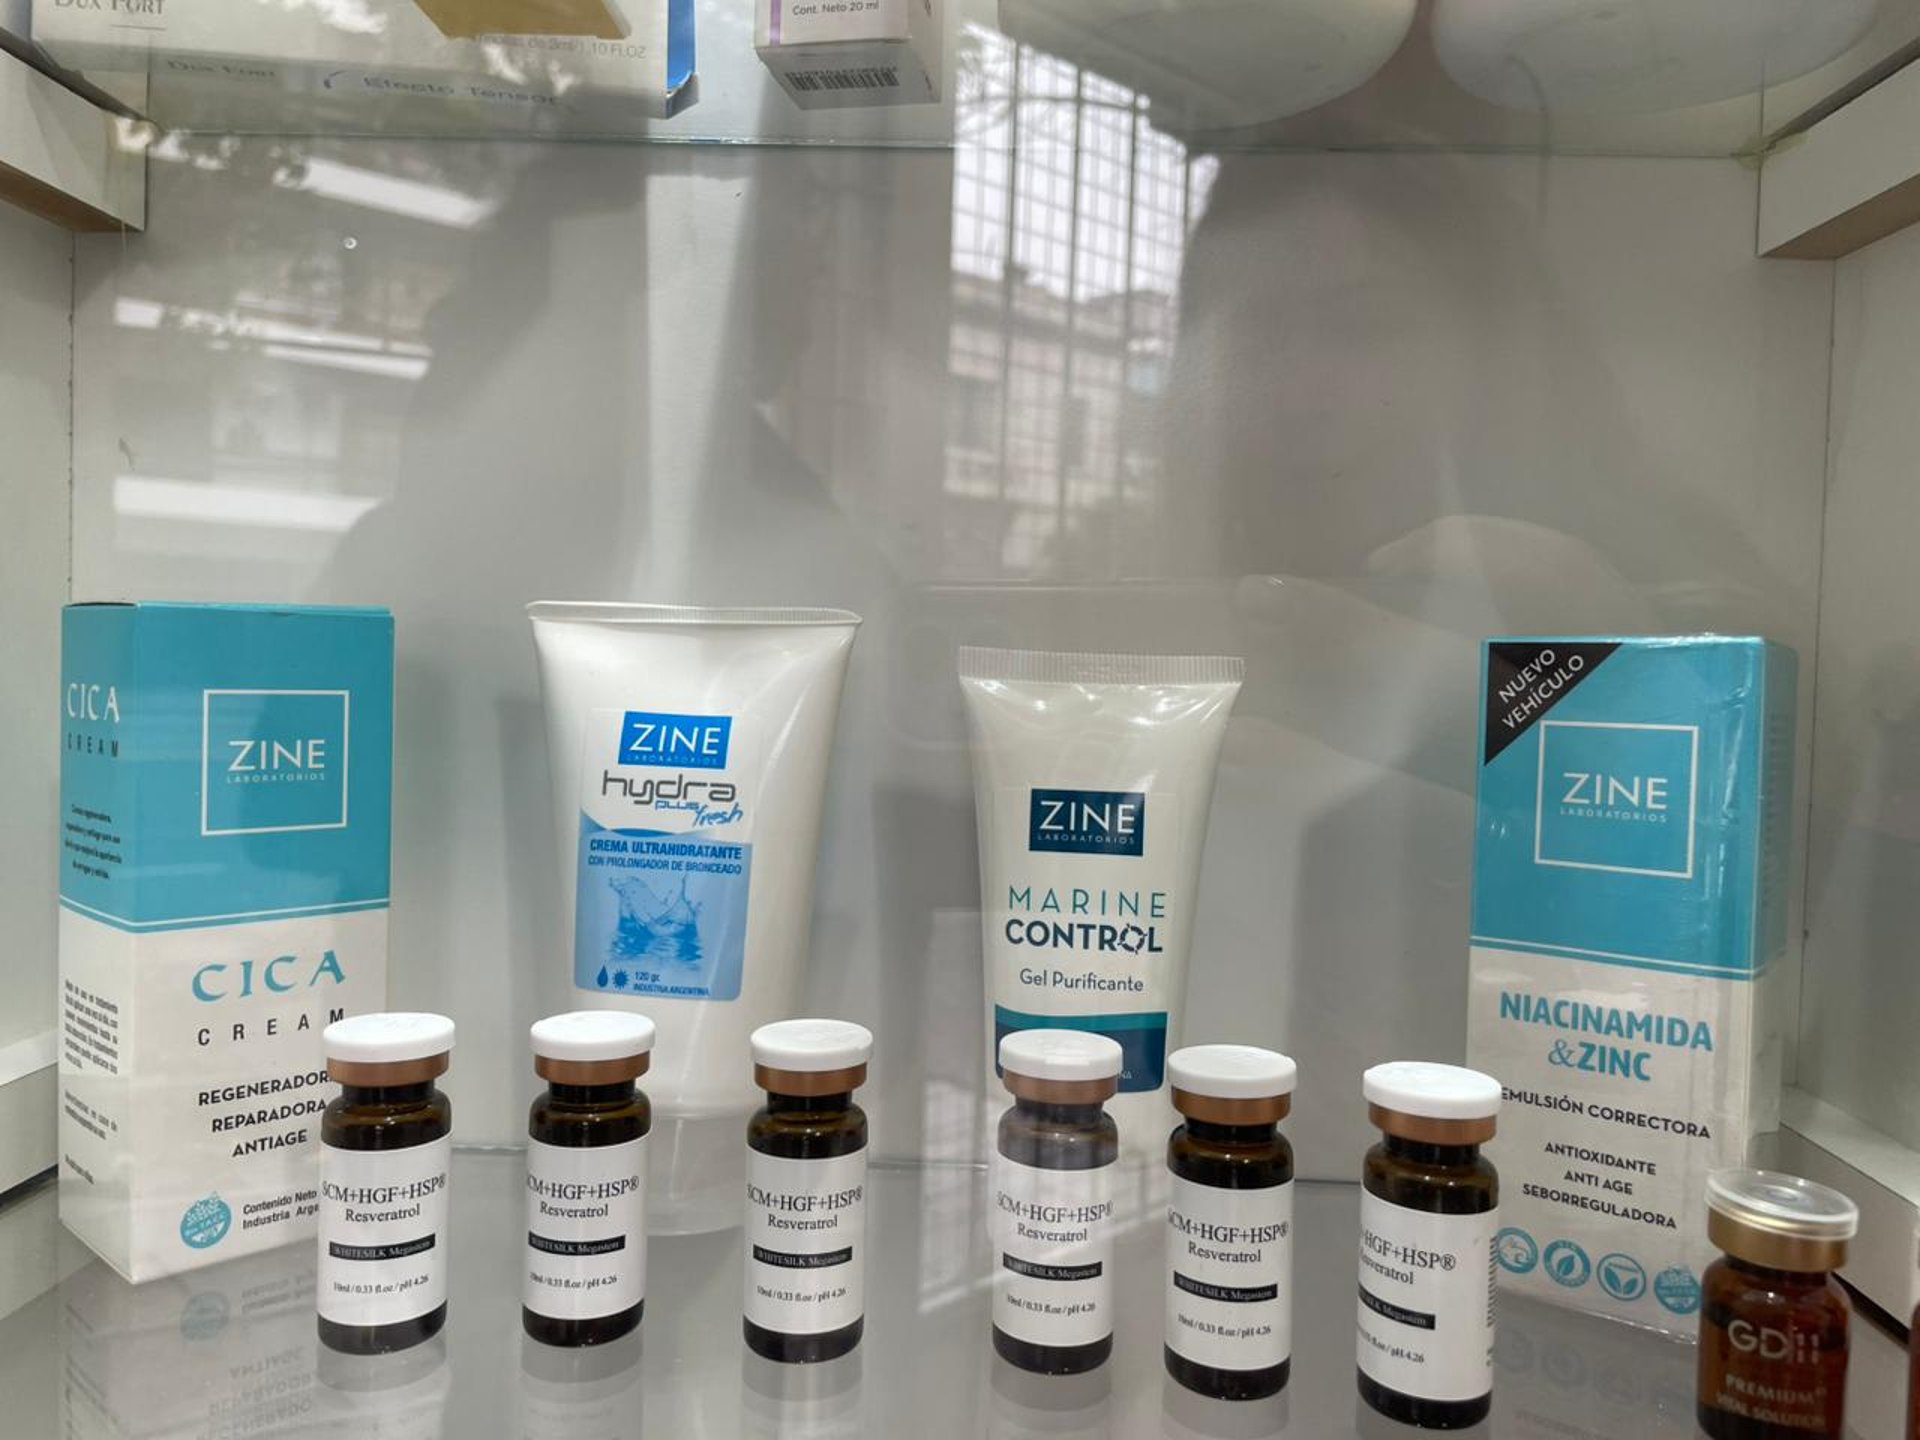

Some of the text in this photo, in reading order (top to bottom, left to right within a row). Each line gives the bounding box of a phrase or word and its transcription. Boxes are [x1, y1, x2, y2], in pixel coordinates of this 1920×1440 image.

[793, 0, 879, 16] Cont. Neto 20 ml
[1498, 649, 1556, 705] NUEVO
[1501, 653, 1585, 730] VEHÍCULO
[67, 682, 120, 724] CICA
[227, 739, 325, 771] ZINE
[629, 723, 722, 755] ZINE
[226, 772, 325, 784] LABORATORIOS
[602, 769, 737, 805] hydra
[1561, 772, 1669, 810] ZINE
[692, 802, 744, 828] fresh
[1039, 800, 1136, 834] ZINE
[1560, 806, 1668, 824] LABORATORIOS
[589, 839, 743, 860] CREMA ULTRAHIDRATANTE
[1037, 834, 1136, 845] LABORATORIOS
[588, 855, 742, 875] CON PROLONGADOR DE BRONCEADO
[1008, 884, 1167, 918] MARINE
[1005, 918, 1164, 955] CONTROL
[192, 949, 346, 1002] CICA
[1019, 967, 1145, 992] Gel Purificante
[197, 1007, 345, 1046] CREAM
[1500, 990, 1713, 1052] NIACINAMIDA
[1547, 1038, 1652, 1081] &ZINC
[198, 1070, 329, 1106] REGENERADOR
[212, 1099, 327, 1133] REPARADORA
[1501, 1086, 1711, 1139] EMULSIÓN CORRECTORA
[232, 1129, 308, 1157] ANTIAGE
[1544, 1141, 1657, 1176] ANTIOXIDANTE
[1563, 1169, 1633, 1196] ANTI AGE
[242, 1211, 290, 1230] Industria
[296, 1203, 319, 1217] Arge
[243, 1190, 317, 1215] Contenido Neto
[345, 1203, 420, 1222] Resveratrol
[540, 1200, 609, 1218] Resveratrol
[1522, 1182, 1677, 1230] SEBORREGULADORA
[768, 1213, 838, 1230] Resveratrol
[1017, 1222, 1087, 1242] Resveratrol
[1188, 1240, 1261, 1263] Resveratrol
[1363, 1229, 1456, 1271] HGF+HSP®
